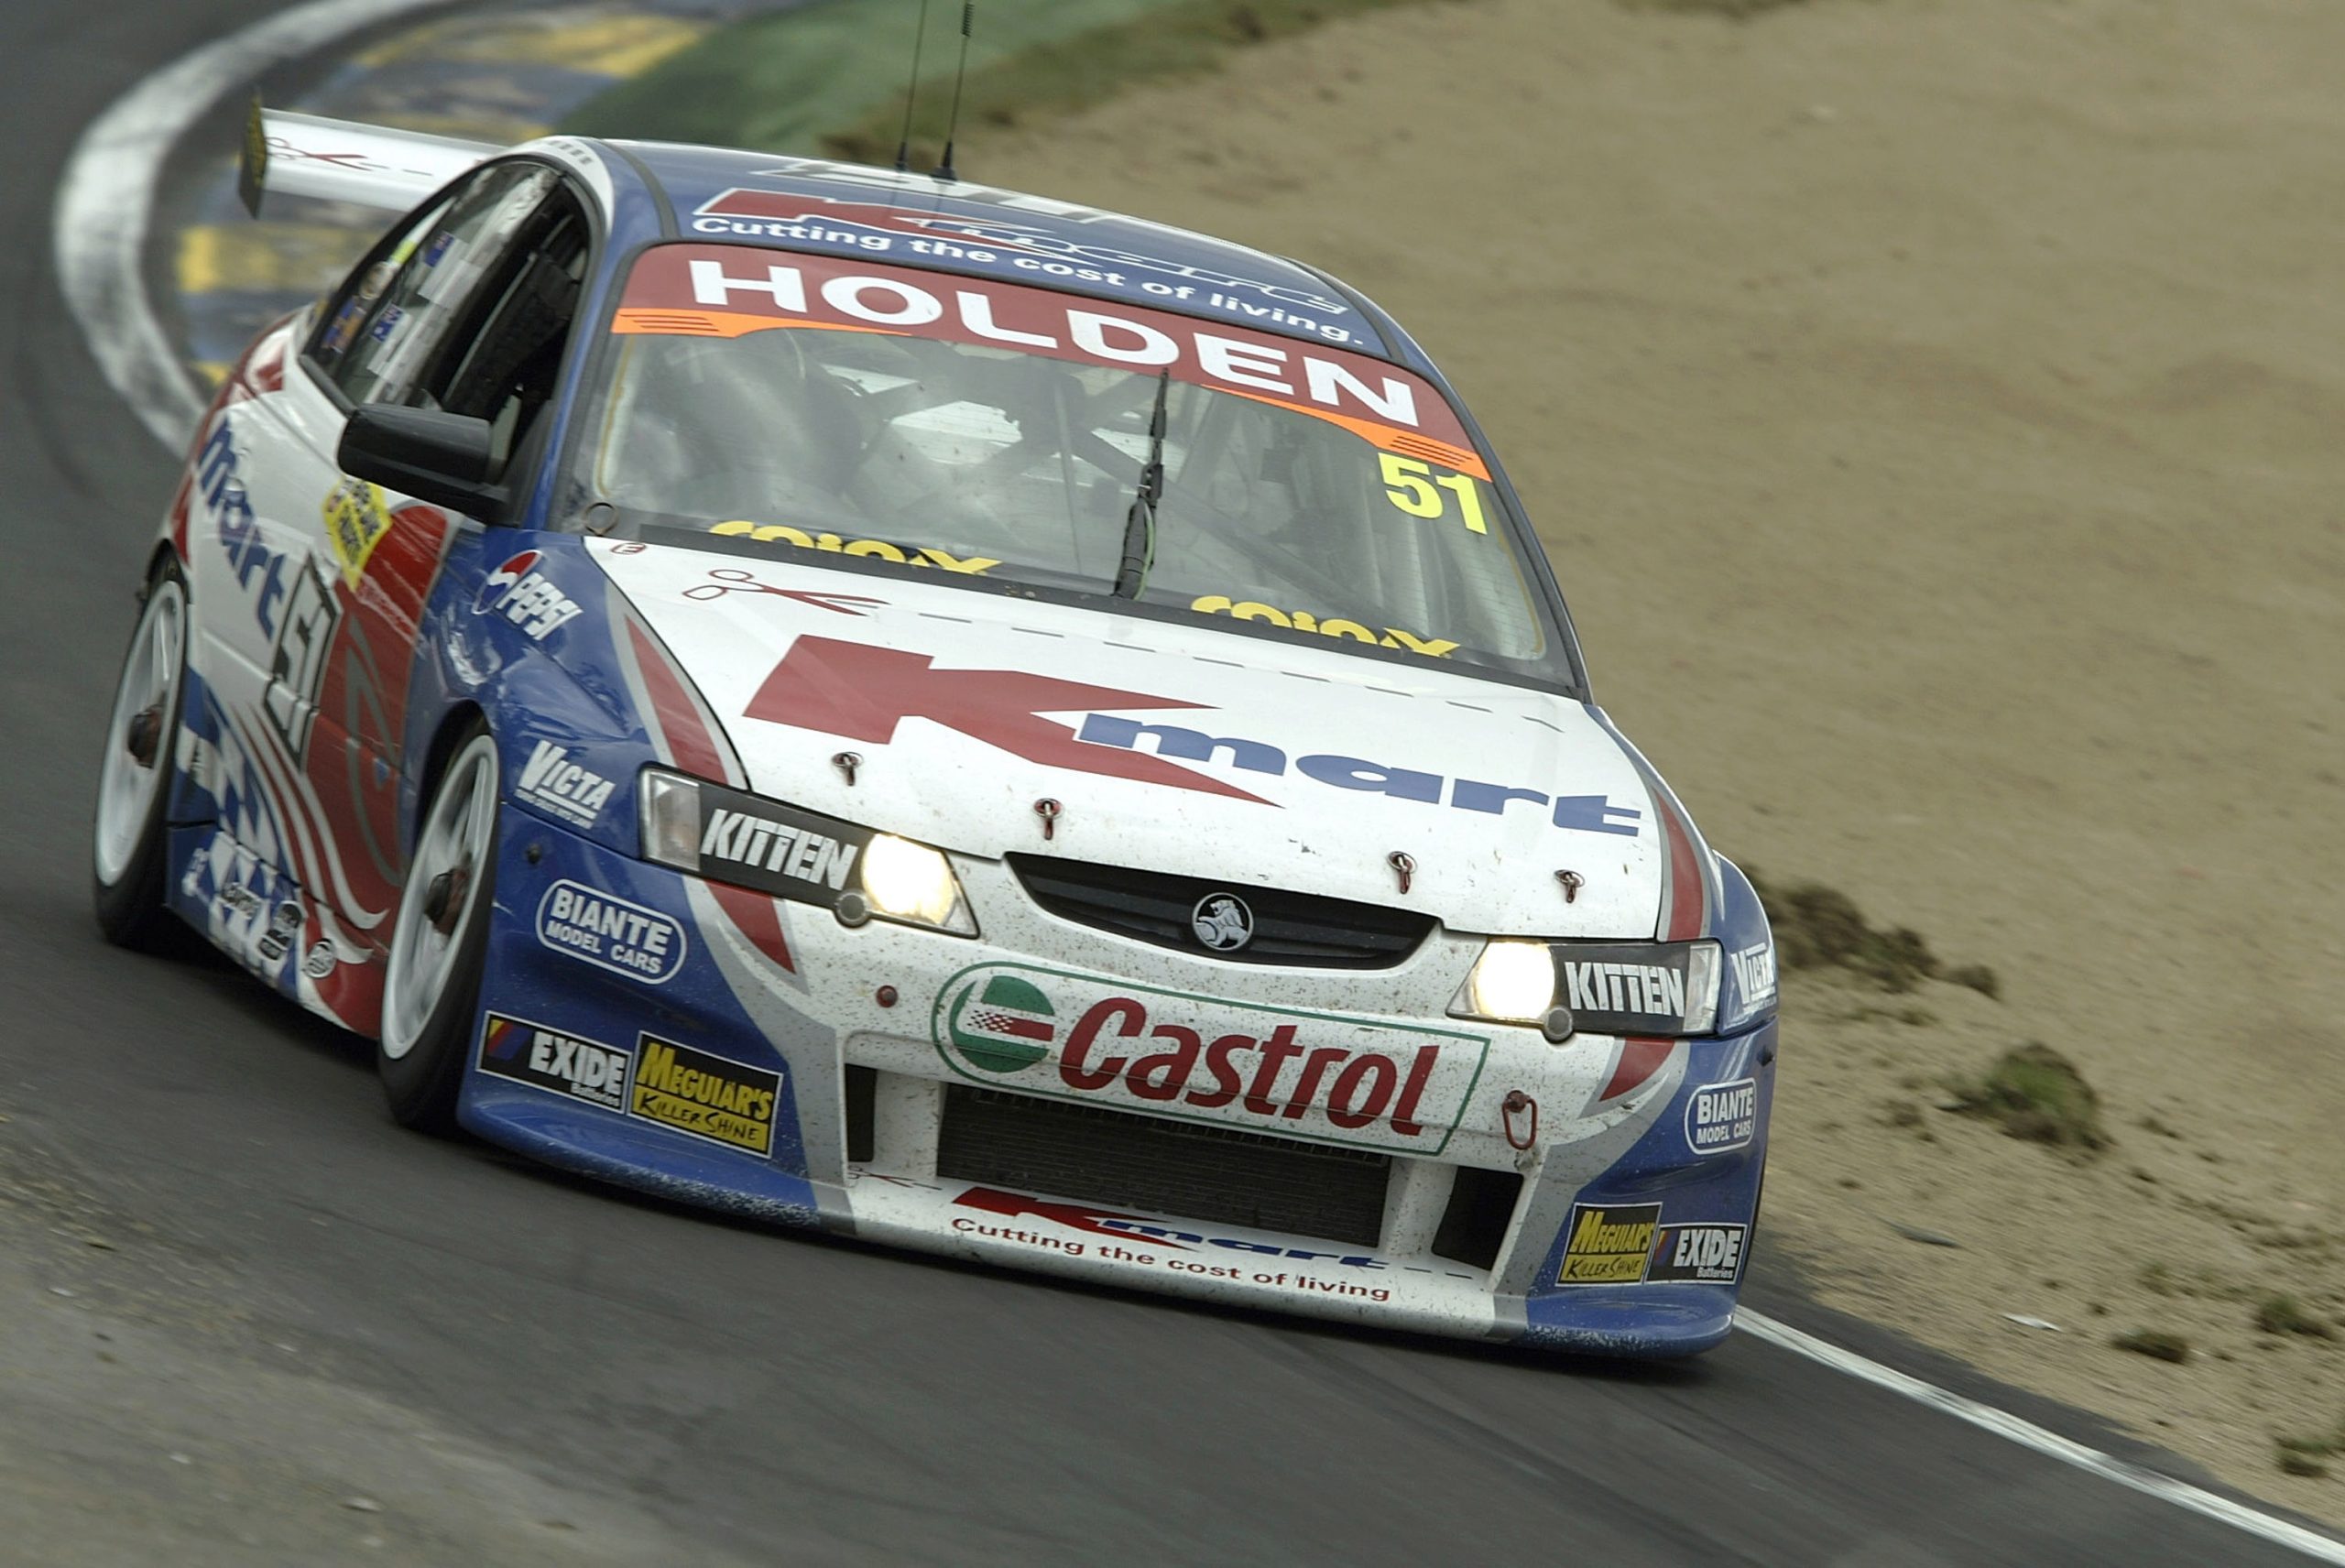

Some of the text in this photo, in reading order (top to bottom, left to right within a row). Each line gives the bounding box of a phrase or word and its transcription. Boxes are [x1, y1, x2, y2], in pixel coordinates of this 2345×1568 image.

[692, 218, 892, 251] Cutting
[911, 239, 998, 263] the
[1013, 257, 1126, 287] cost
[1141, 280, 1195, 299] of
[688, 259, 1419, 428] HOLDEN
[1378, 452, 1489, 534] 51
[496, 572, 584, 640] PEPSI
[742, 634, 1641, 837] Kmart
[518, 739, 616, 811] VICTA
[701, 808, 858, 890] KITTEN
[545, 920, 662, 975] MODEL CARS
[551, 887, 673, 955] BIANTE
[1565, 962, 1685, 1018] KITTEN
[529, 1030, 627, 1095] EXIDE
[1059, 997, 1440, 1137] Castrol
[1696, 1119, 1751, 1144] MODEL CARS
[1697, 1087, 1753, 1133] BIANTE
[951, 1217, 1391, 1302] Cutting the cost of living
[952, 1186, 1390, 1270] Kmart
[1673, 1229, 1742, 1268] EXIDE
[1696, 1268, 1733, 1279] Batteries
